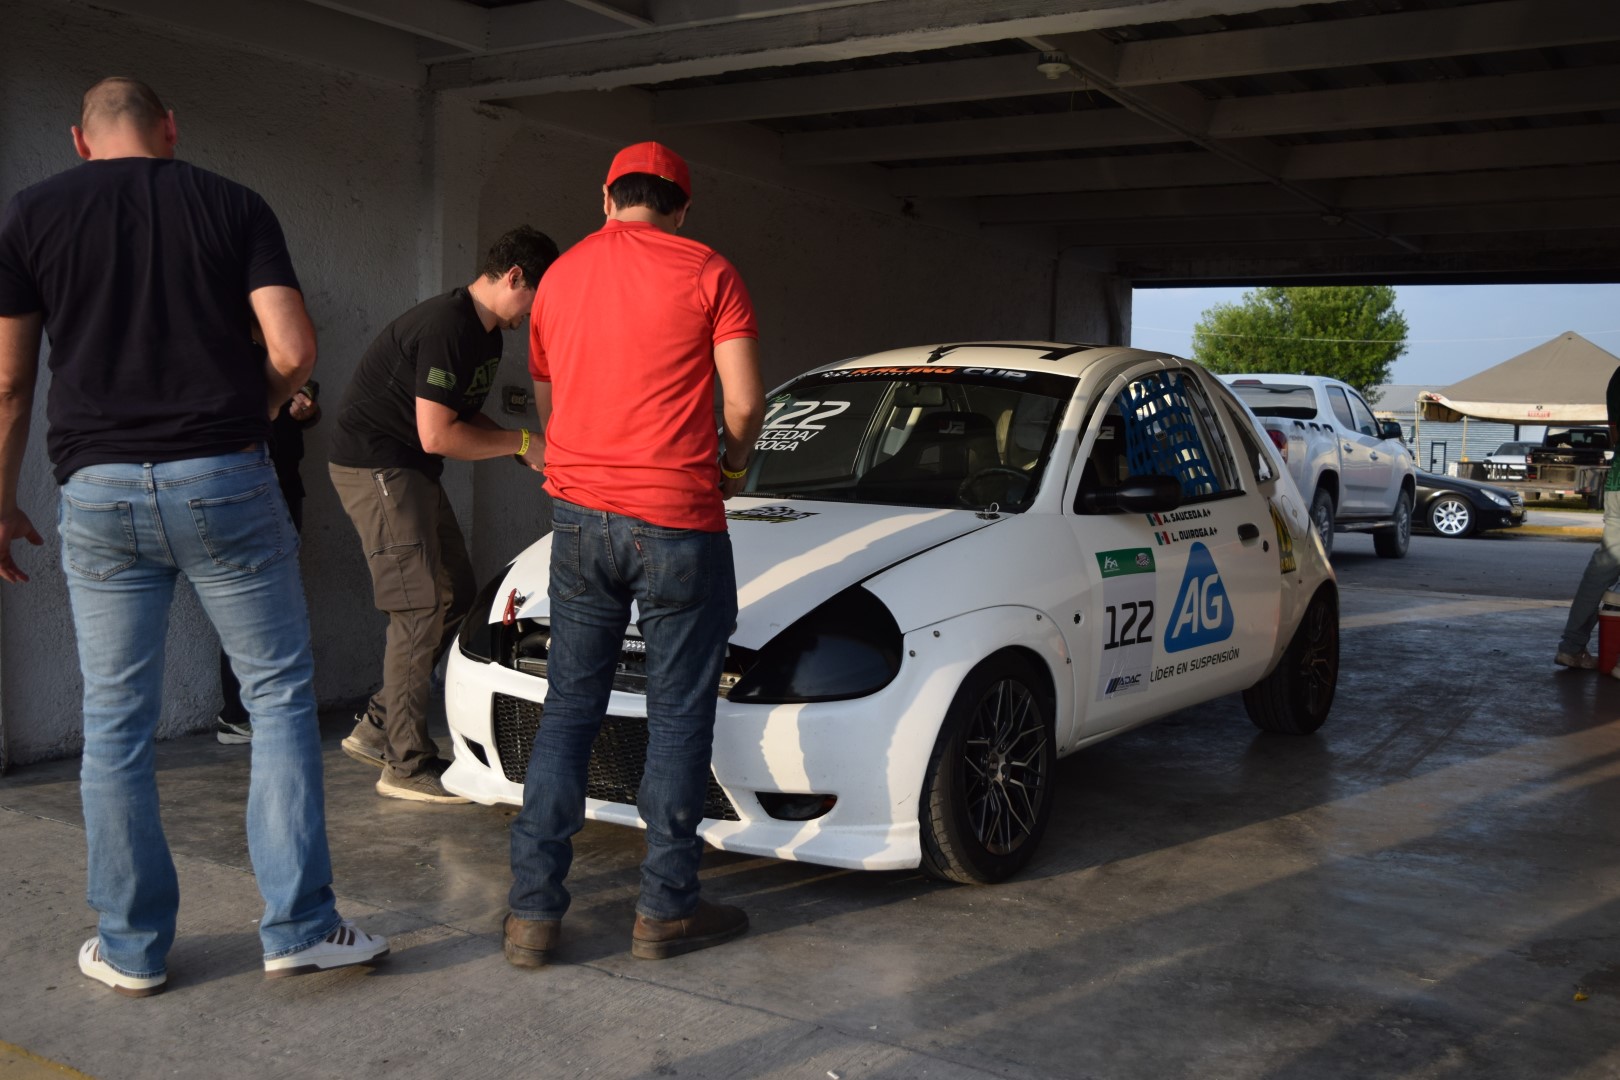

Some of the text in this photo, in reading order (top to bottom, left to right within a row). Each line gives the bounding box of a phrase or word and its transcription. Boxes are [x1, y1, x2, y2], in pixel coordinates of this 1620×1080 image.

[962, 367, 1028, 383] CUP
[762, 400, 851, 431] 122
[754, 440, 799, 451] ROGA
[1170, 509, 1203, 523] SAUCEDA
[1171, 573, 1223, 639] AG
[1104, 600, 1154, 650] 122
[1150, 646, 1240, 683] LÍDER EN SUSPENSIÓN
